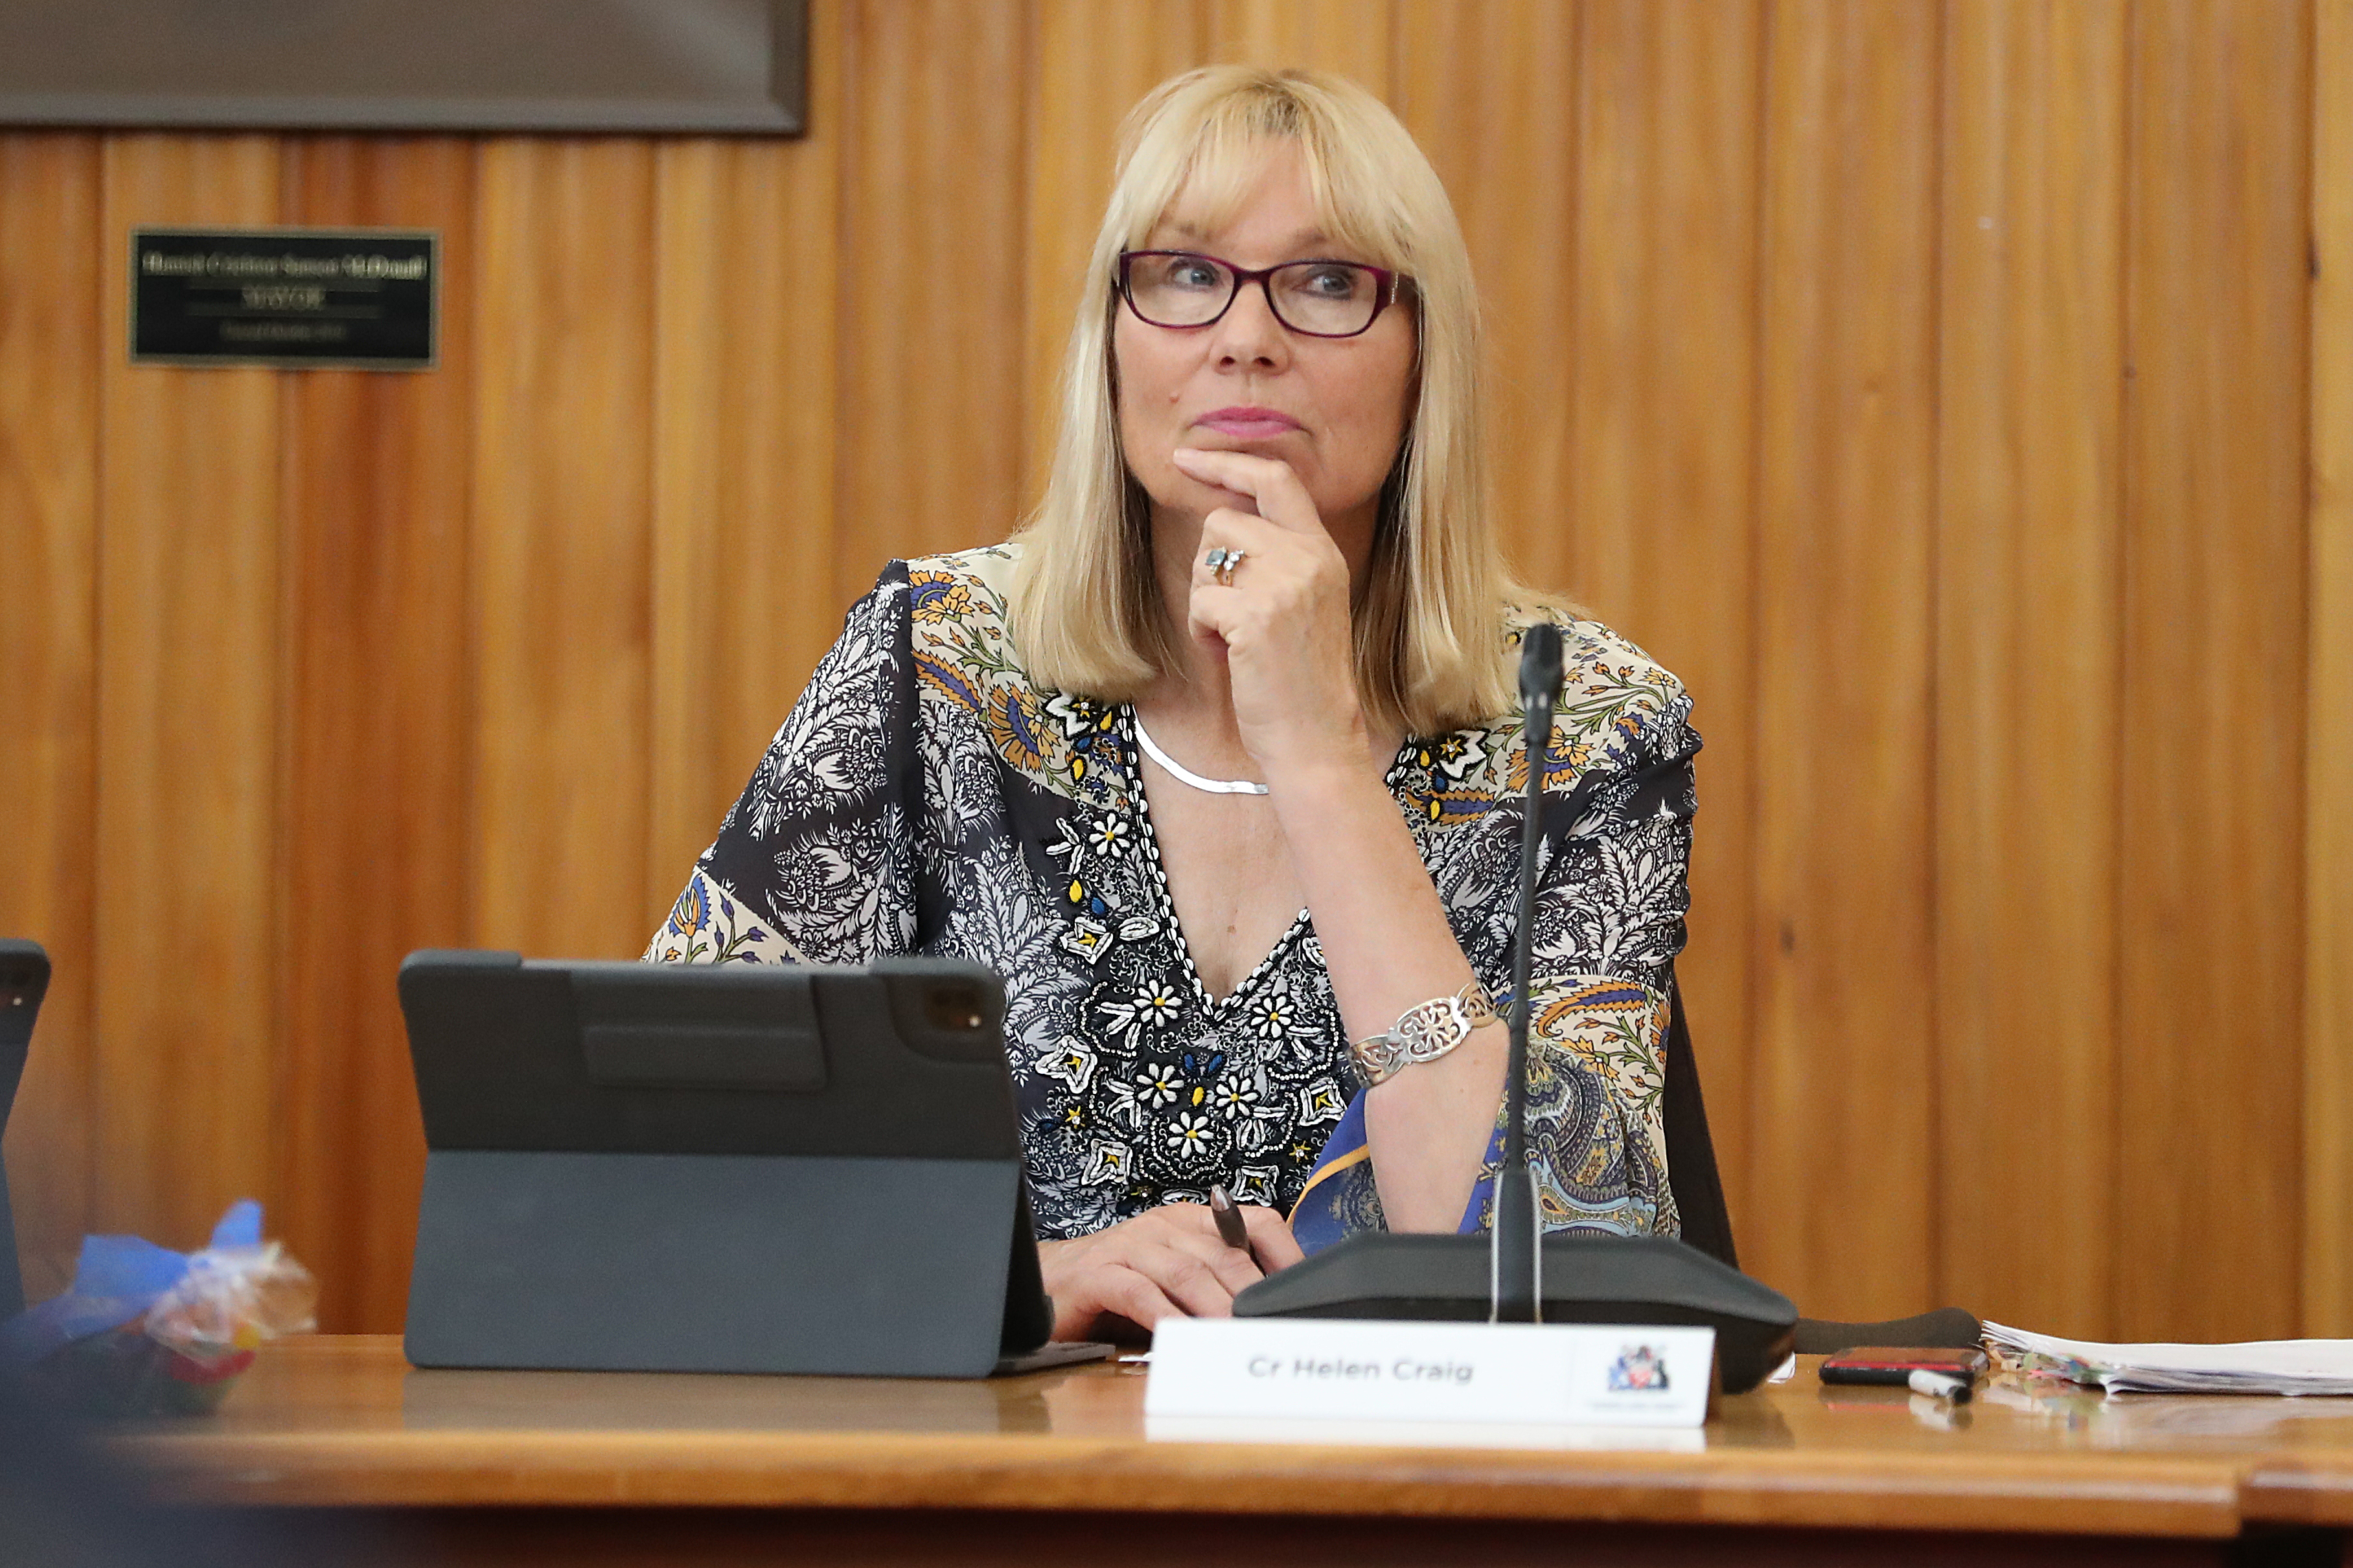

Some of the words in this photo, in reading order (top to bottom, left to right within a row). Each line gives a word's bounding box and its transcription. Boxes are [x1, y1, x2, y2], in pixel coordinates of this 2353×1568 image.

[1247, 1356, 1281, 1378] Cr
[1292, 1358, 1381, 1380] Helen
[1392, 1359, 1473, 1385] Craig
